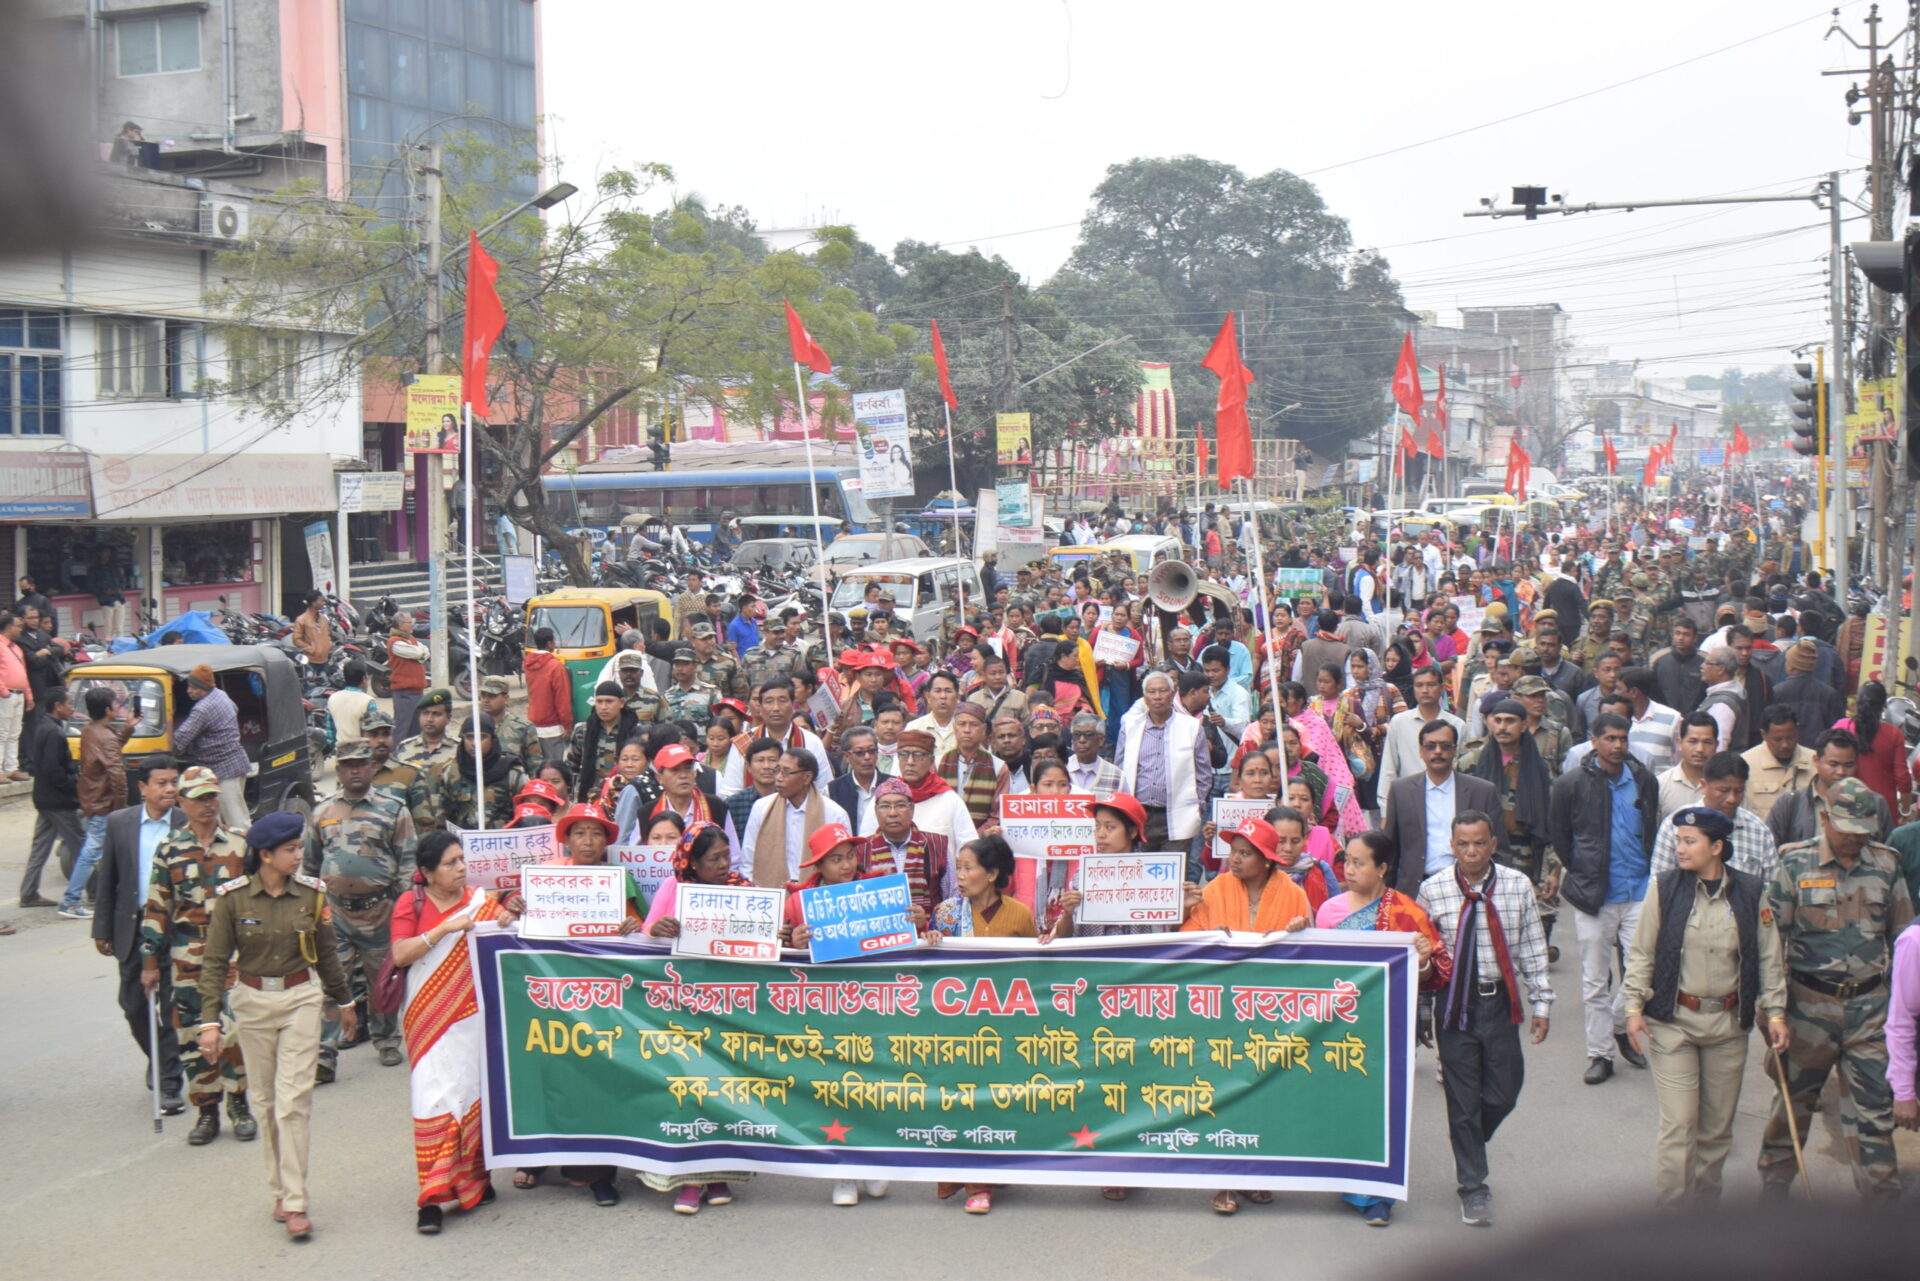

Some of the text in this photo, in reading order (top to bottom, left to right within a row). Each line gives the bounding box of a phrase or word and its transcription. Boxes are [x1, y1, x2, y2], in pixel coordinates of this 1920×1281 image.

[619, 850, 646, 863] No
[637, 868, 647, 878] to
[1129, 910, 1178, 920] GMP
[569, 924, 620, 935] GMP
[862, 931, 911, 949] GMP
[931, 976, 1039, 1017] CAA
[1091, 1026, 1136, 1067] বিল
[1149, 1033, 1195, 1068] পাশ
[1321, 1031, 1369, 1076] নাই
[939, 1081, 977, 1112] ৮ম
[1100, 1079, 1129, 1115] মা
[725, 1121, 778, 1139] পরিষদ
[963, 1126, 1017, 1145] পরিষদ
[1204, 1130, 1261, 1150] পরিষদ
